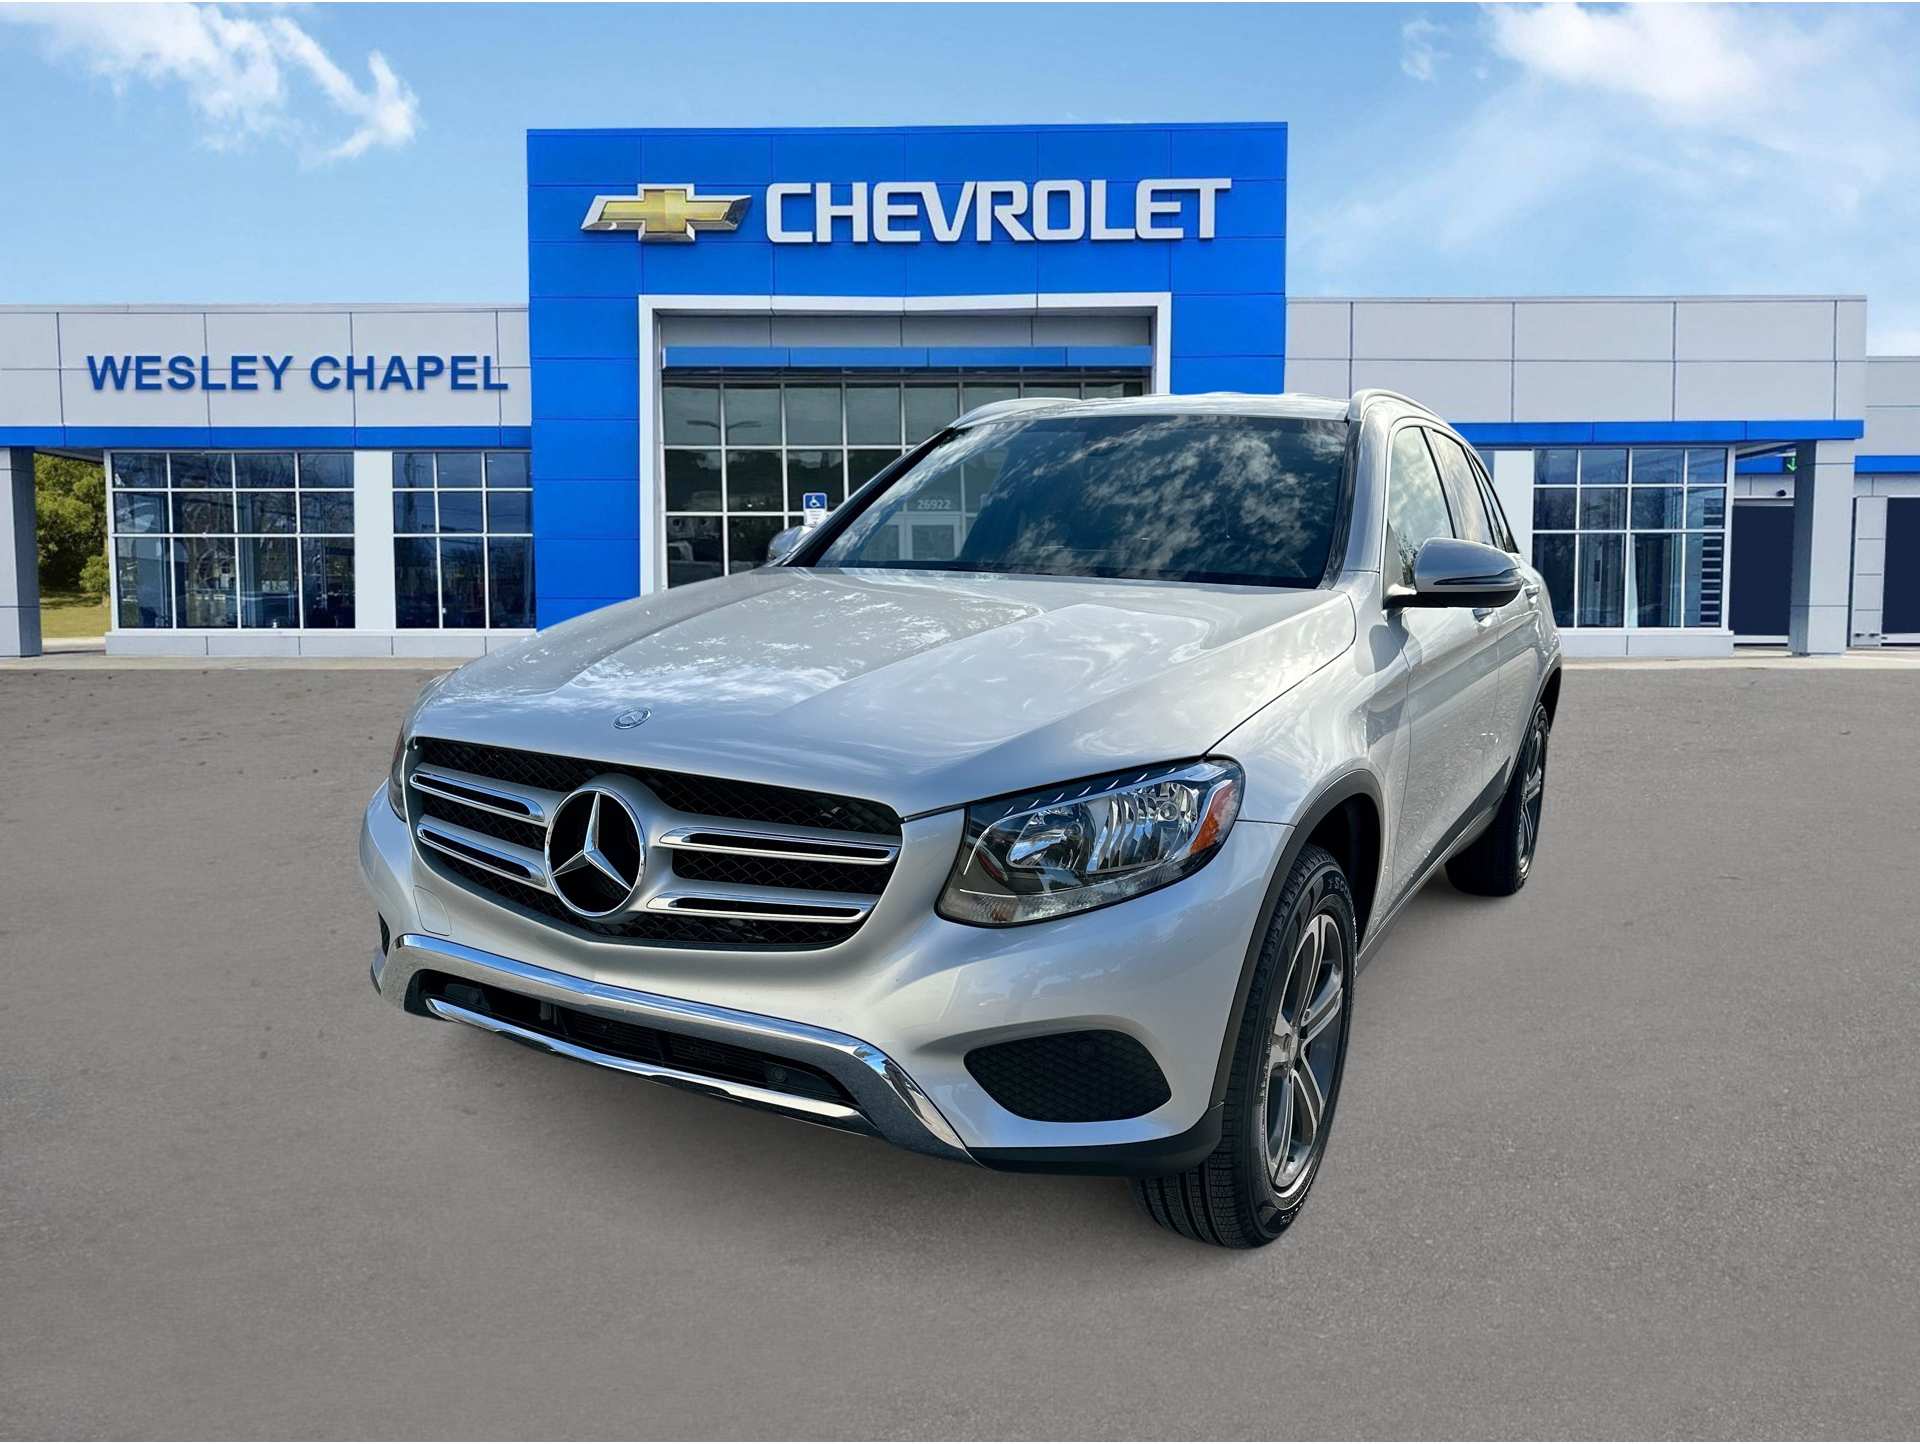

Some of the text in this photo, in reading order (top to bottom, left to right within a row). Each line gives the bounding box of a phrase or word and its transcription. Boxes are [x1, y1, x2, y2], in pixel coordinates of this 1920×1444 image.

[766, 177, 1232, 244] CHEVROLET
[86, 355, 509, 391] WESLEY CHAPEL
